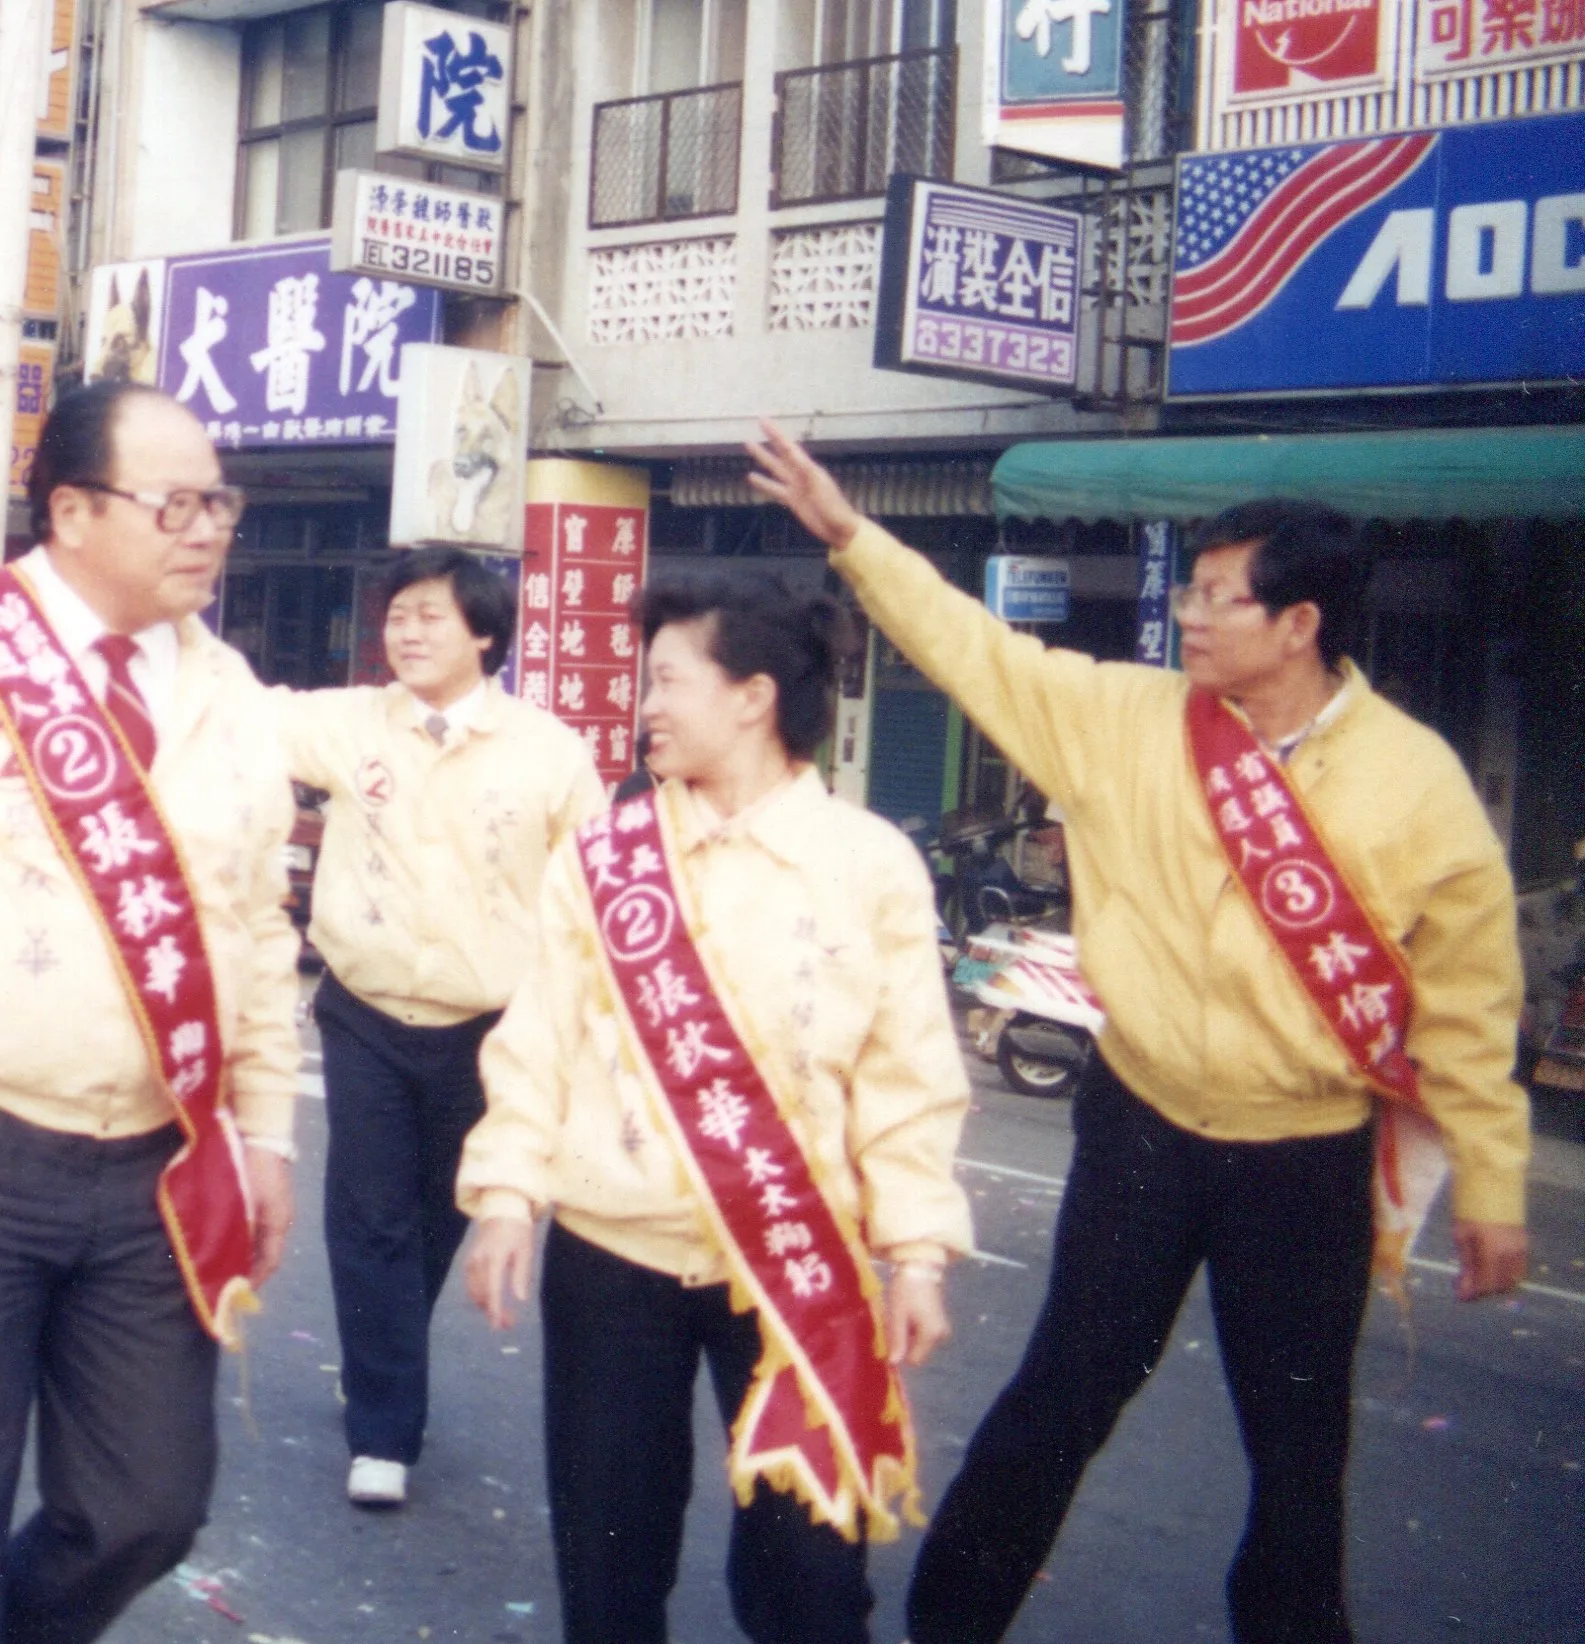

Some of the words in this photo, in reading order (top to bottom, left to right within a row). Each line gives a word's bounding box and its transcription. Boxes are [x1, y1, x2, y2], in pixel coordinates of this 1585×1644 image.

[1244, 0, 1375, 28] Nationa
[416, 31, 504, 153] 院
[362, 237, 389, 268] TEL
[391, 244, 494, 286] 321185
[175, 273, 416, 416] 犬醫院
[1235, 751, 1303, 851] 省議員
[79, 801, 186, 1005] 張秋華
[636, 958, 751, 1150] 張秋華
[742, 1146, 833, 1299] 太太鞠躬
